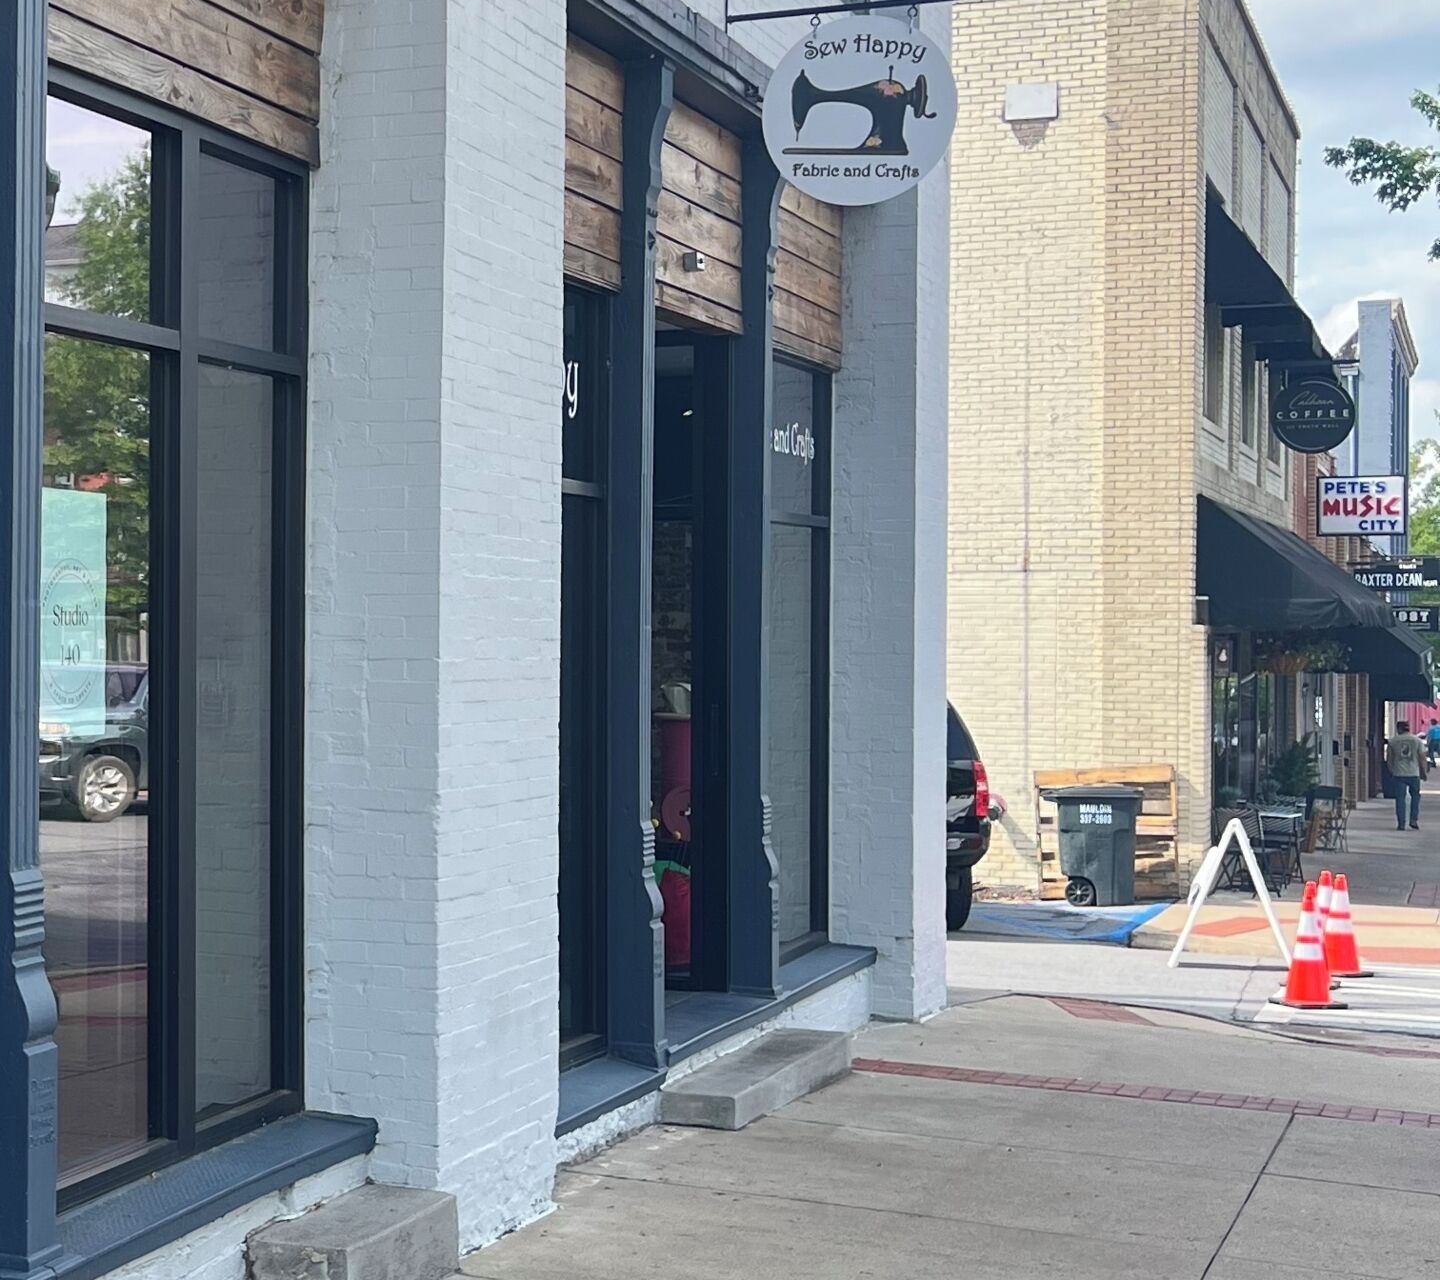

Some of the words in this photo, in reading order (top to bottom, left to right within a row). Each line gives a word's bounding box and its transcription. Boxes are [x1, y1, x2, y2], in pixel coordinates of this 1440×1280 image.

[804, 37, 847, 60] Sew
[853, 33, 927, 63] Happy
[792, 162, 840, 178] Fabric
[843, 162, 871, 178] and
[875, 163, 920, 181] Crafts
[1276, 409, 1350, 420] COFFEE
[773, 423, 790, 455] and
[791, 422, 815, 466] Crafts
[1324, 480, 1386, 495] PETE'S
[1323, 495, 1400, 517] MUSIC
[1358, 519, 1398, 531] CITY
[1395, 573, 1423, 587] DEAN
[52, 604, 89, 627] Studio
[60, 643, 81, 666] 140
